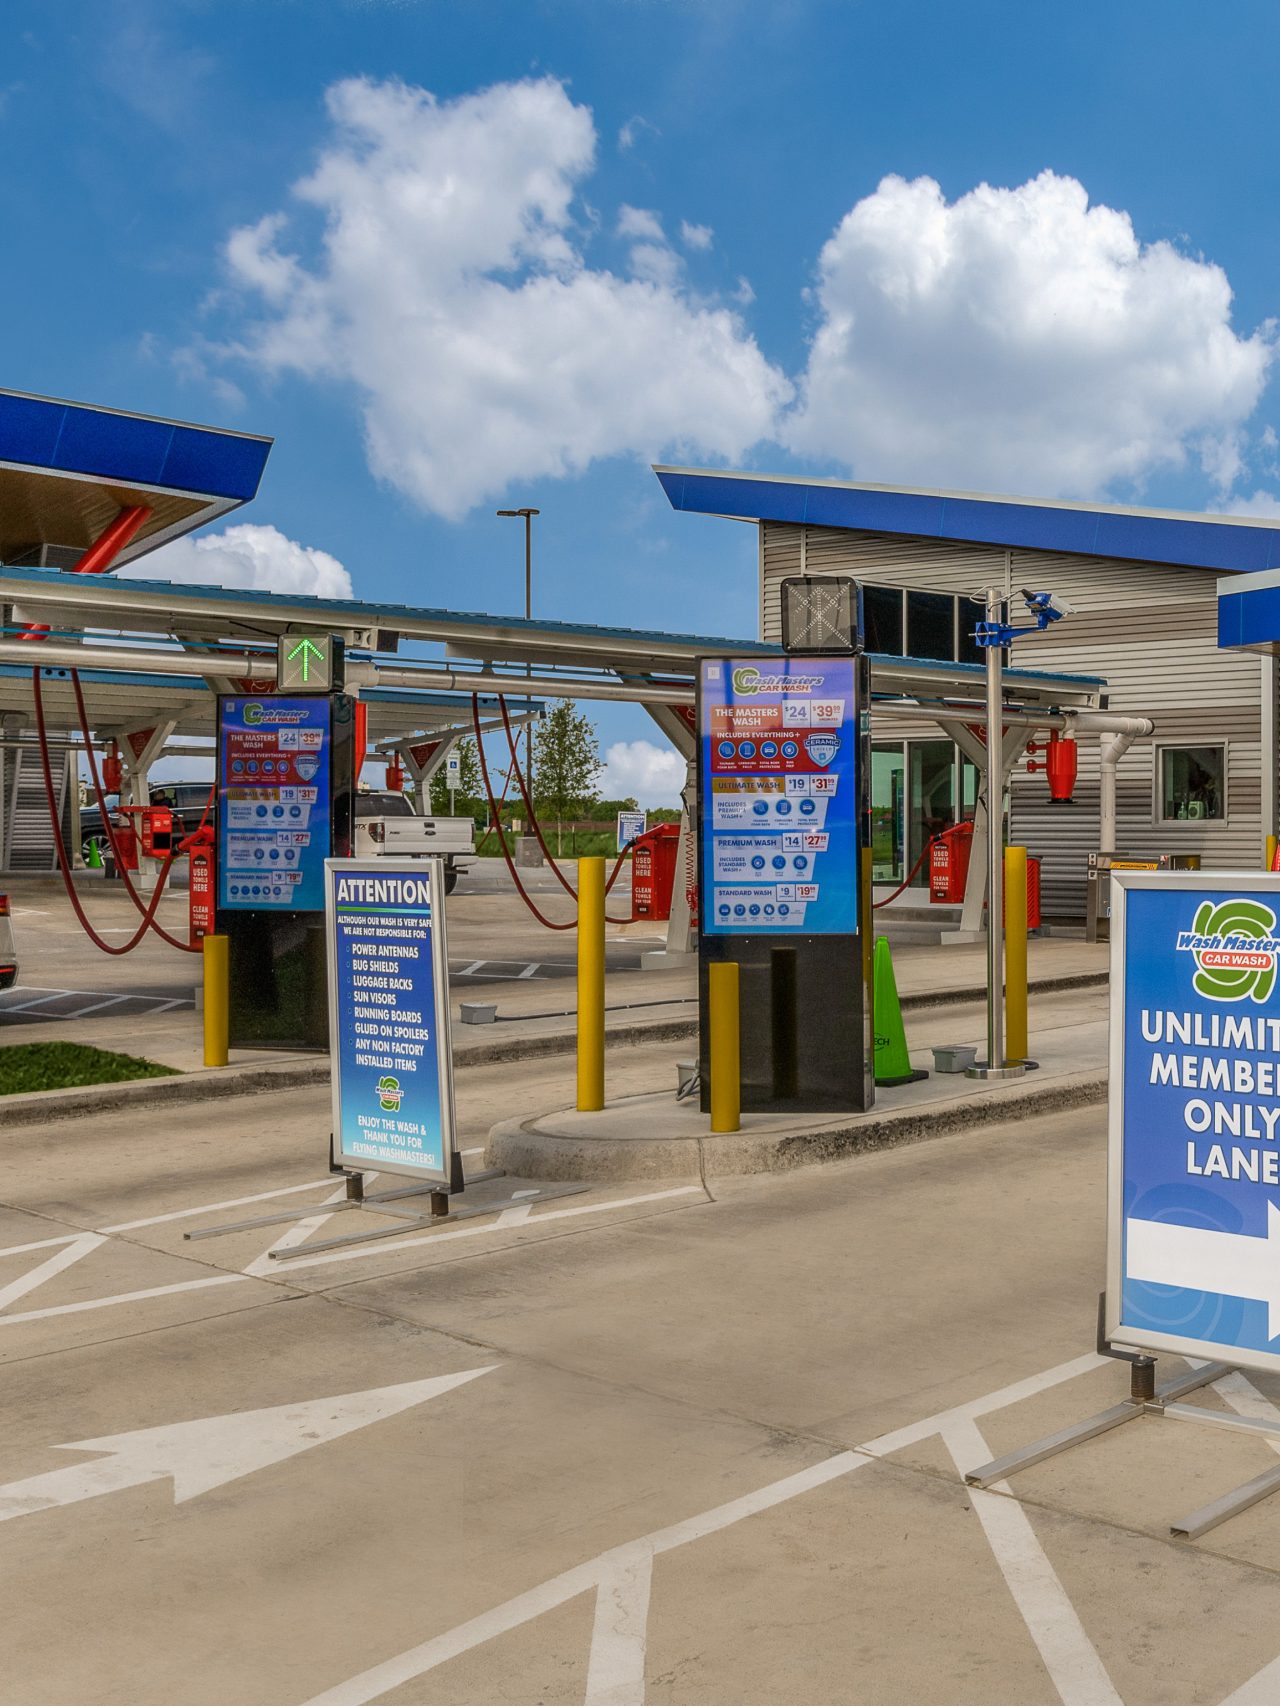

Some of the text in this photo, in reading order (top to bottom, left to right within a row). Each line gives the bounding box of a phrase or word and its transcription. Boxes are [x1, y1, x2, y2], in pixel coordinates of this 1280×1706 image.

[715, 708, 778, 717] THE MASTERS
[732, 717, 761, 726] WASH
[193, 884, 208, 892] HERE
[337, 879, 431, 904] ATTENTION
[338, 916, 366, 925] ALTHOUGH
[367, 917, 379, 925] OUR
[380, 917, 396, 926] WASH
[397, 918, 403, 926] IS
[403, 919, 418, 927] VERY
[343, 927, 352, 935] WE
[353, 927, 362, 935] ARE
[363, 928, 375, 936] NOT
[376, 929, 412, 938] RESPONSIBLE
[1178, 934, 1222, 949] Wash
[352, 943, 419, 958] POWER ANTENNAS
[353, 959, 399, 973] BUG SHIELDS
[1205, 954, 1267, 966] CAR WASH
[353, 975, 413, 990] LUGGAGE RACKS
[353, 991, 397, 1005] SUN VISORS
[354, 1007, 422, 1024] RUNNING BOARDS
[355, 1022, 429, 1041] GLUED ON SPOILERS
[356, 1038, 424, 1056] ANY NON FACTORY
[356, 1054, 417, 1072] INSTALLED ITEMS
[358, 1115, 427, 1136] ENJOY THE WASH &
[363, 1130, 422, 1149] THANK YOU FOR
[352, 1141, 377, 1155] FLYING
[1186, 1141, 1280, 1185] LANE
